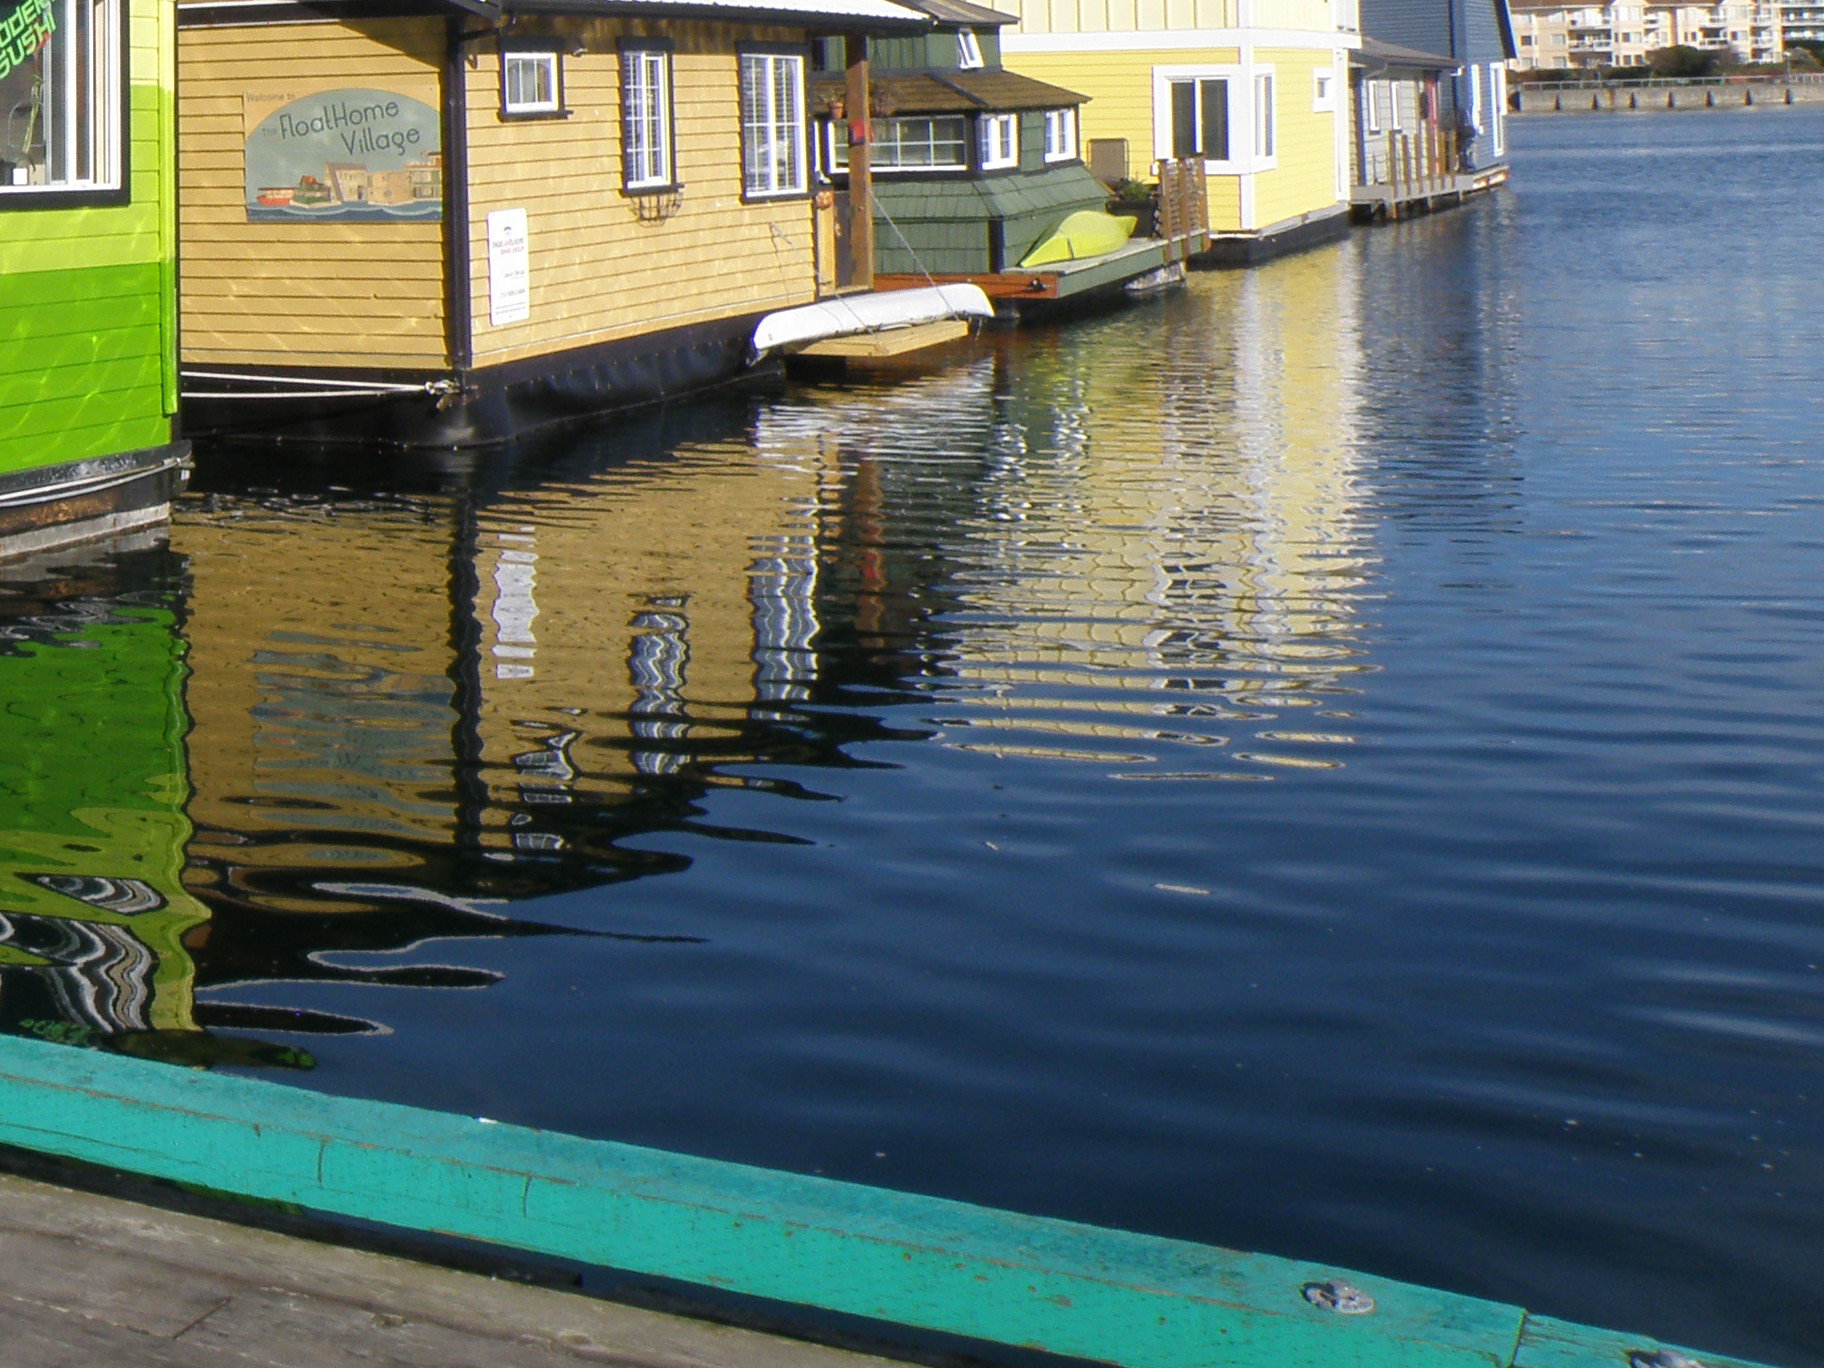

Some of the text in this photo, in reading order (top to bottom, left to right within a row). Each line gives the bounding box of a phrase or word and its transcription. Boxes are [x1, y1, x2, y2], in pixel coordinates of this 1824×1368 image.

[245, 92, 296, 102] Welcome to
[279, 101, 400, 140] FloatHome
[340, 127, 421, 156] Village
